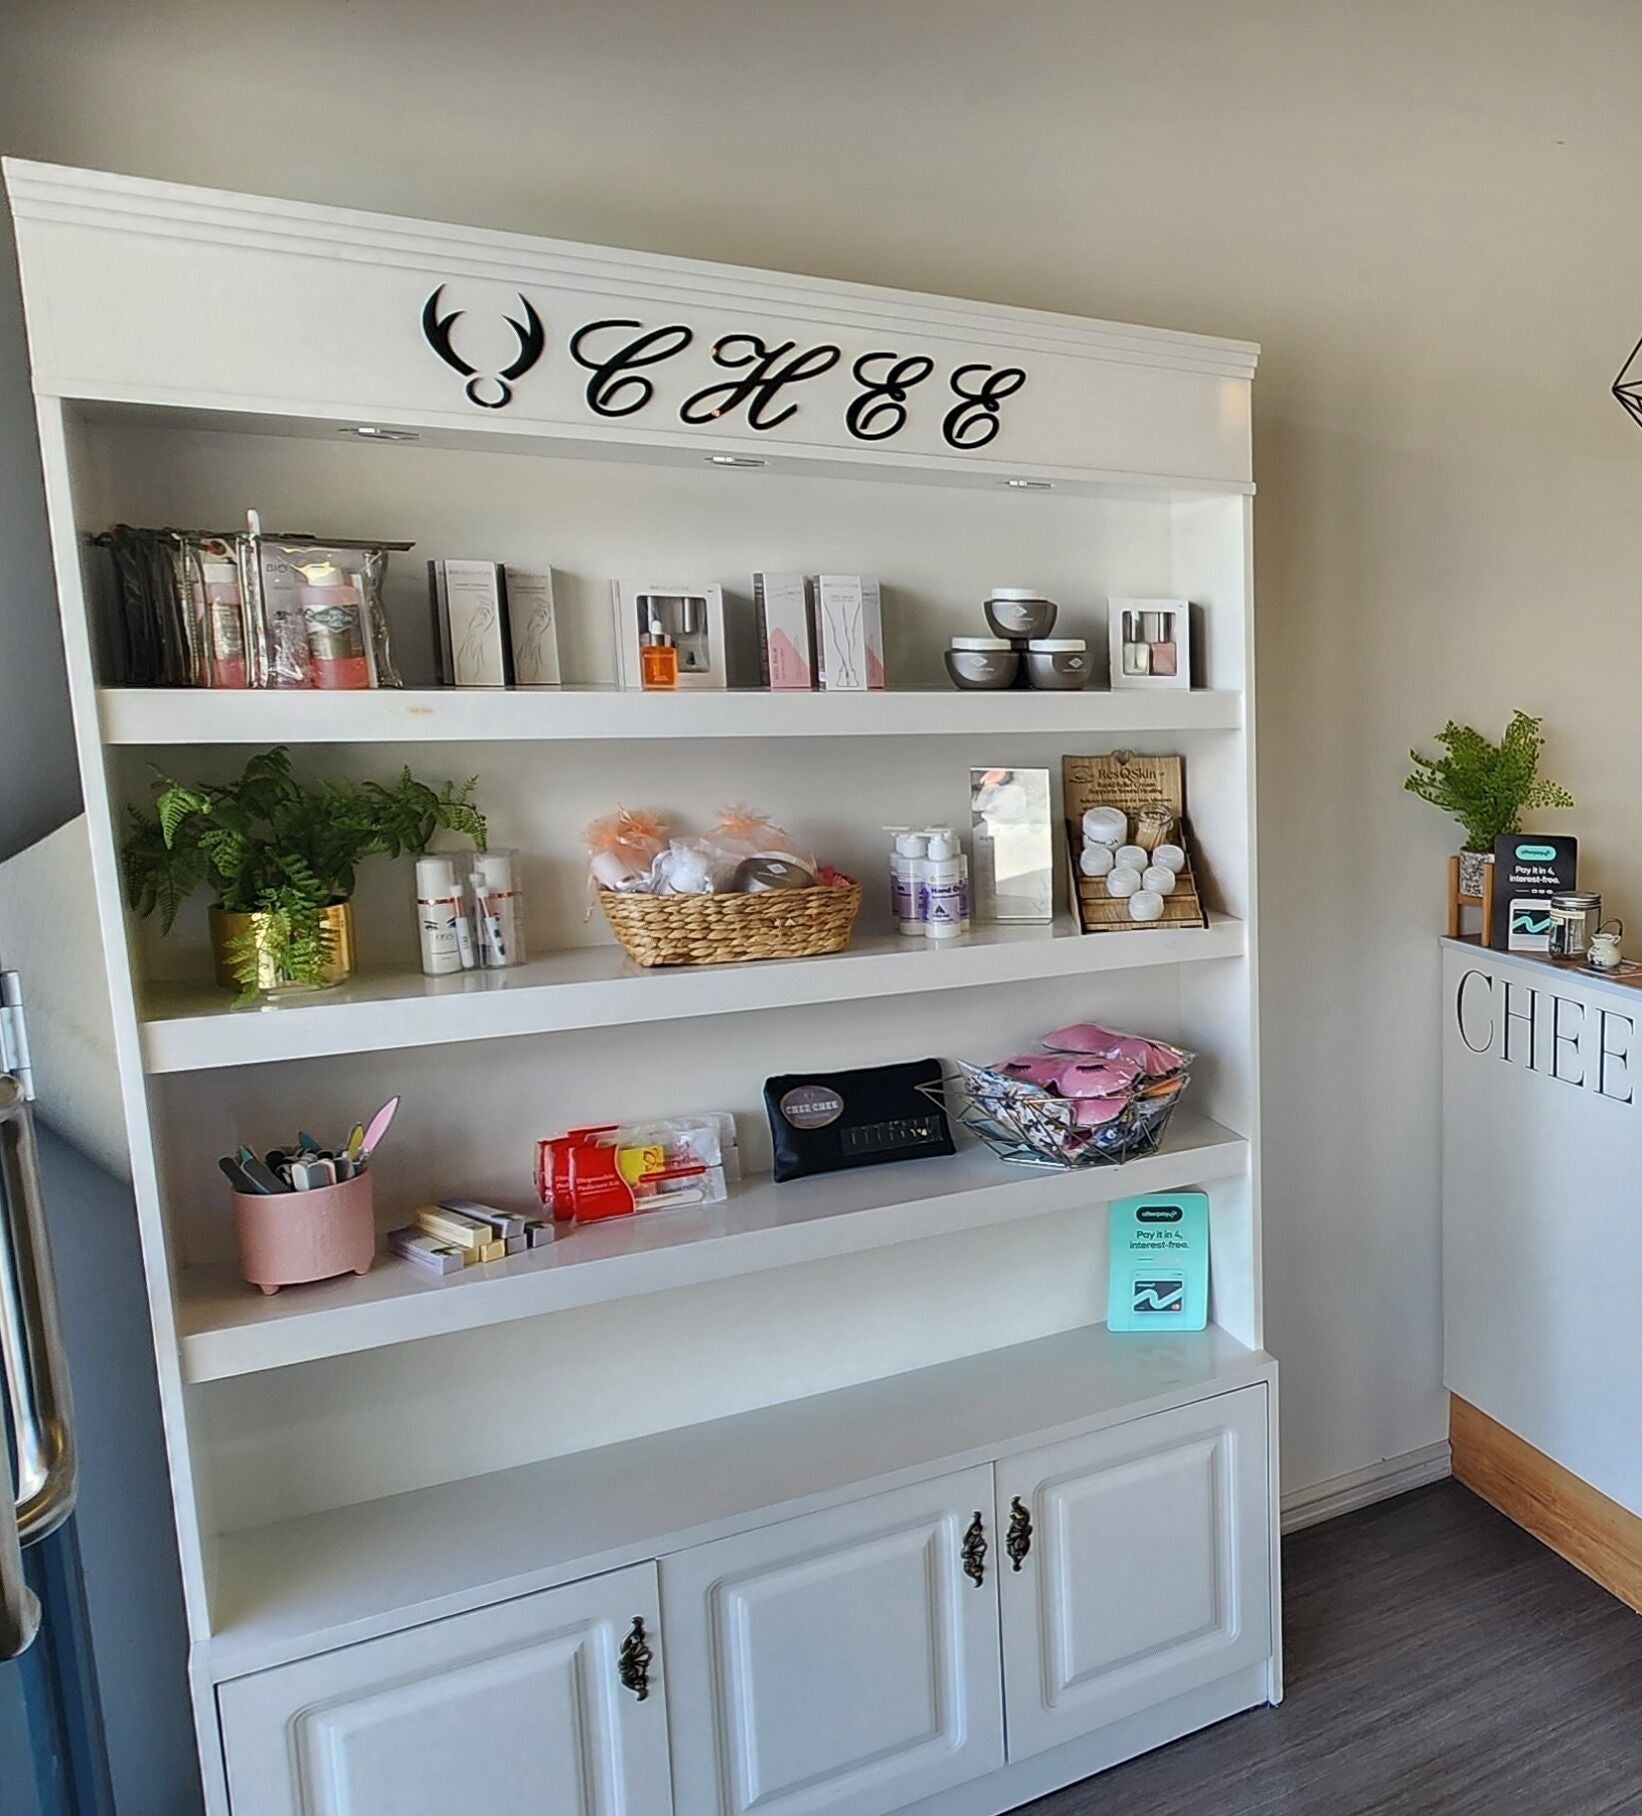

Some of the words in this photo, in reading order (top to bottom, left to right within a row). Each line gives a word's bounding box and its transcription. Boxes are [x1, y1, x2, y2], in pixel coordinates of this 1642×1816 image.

[570, 319, 1026, 450] CHEE
[1515, 865, 1531, 876] Pay
[1456, 969, 1635, 1105] CHEE
[1136, 1230, 1155, 1240] Pay
[1156, 1230, 1163, 1239] it
[1164, 1230, 1173, 1239] in
[1129, 1240, 1189, 1250] interest-free.
